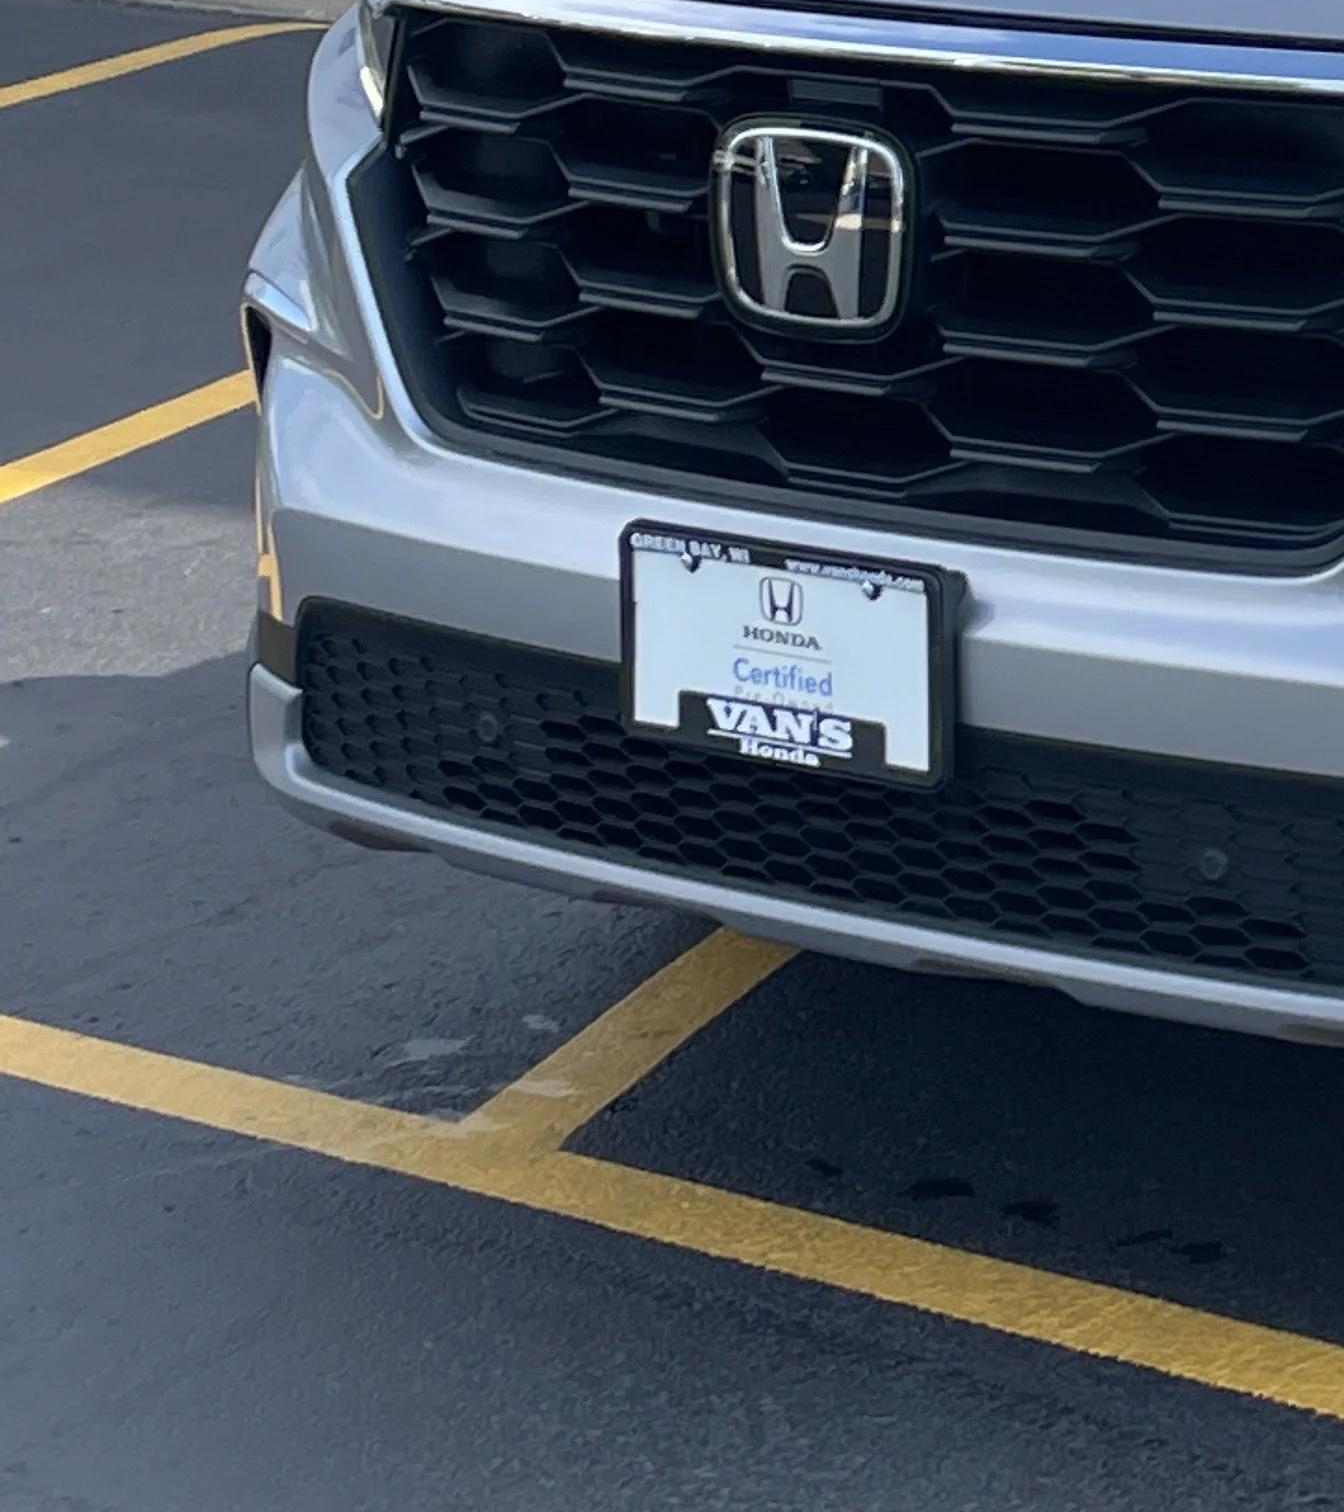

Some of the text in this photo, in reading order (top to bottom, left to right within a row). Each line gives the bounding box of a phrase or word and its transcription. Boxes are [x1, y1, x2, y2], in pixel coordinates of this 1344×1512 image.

[630, 532, 686, 553] GREEN
[728, 546, 751, 564] WI
[742, 624, 822, 651] HONDA
[733, 656, 833, 697] Certified
[738, 736, 822, 768] Honda
